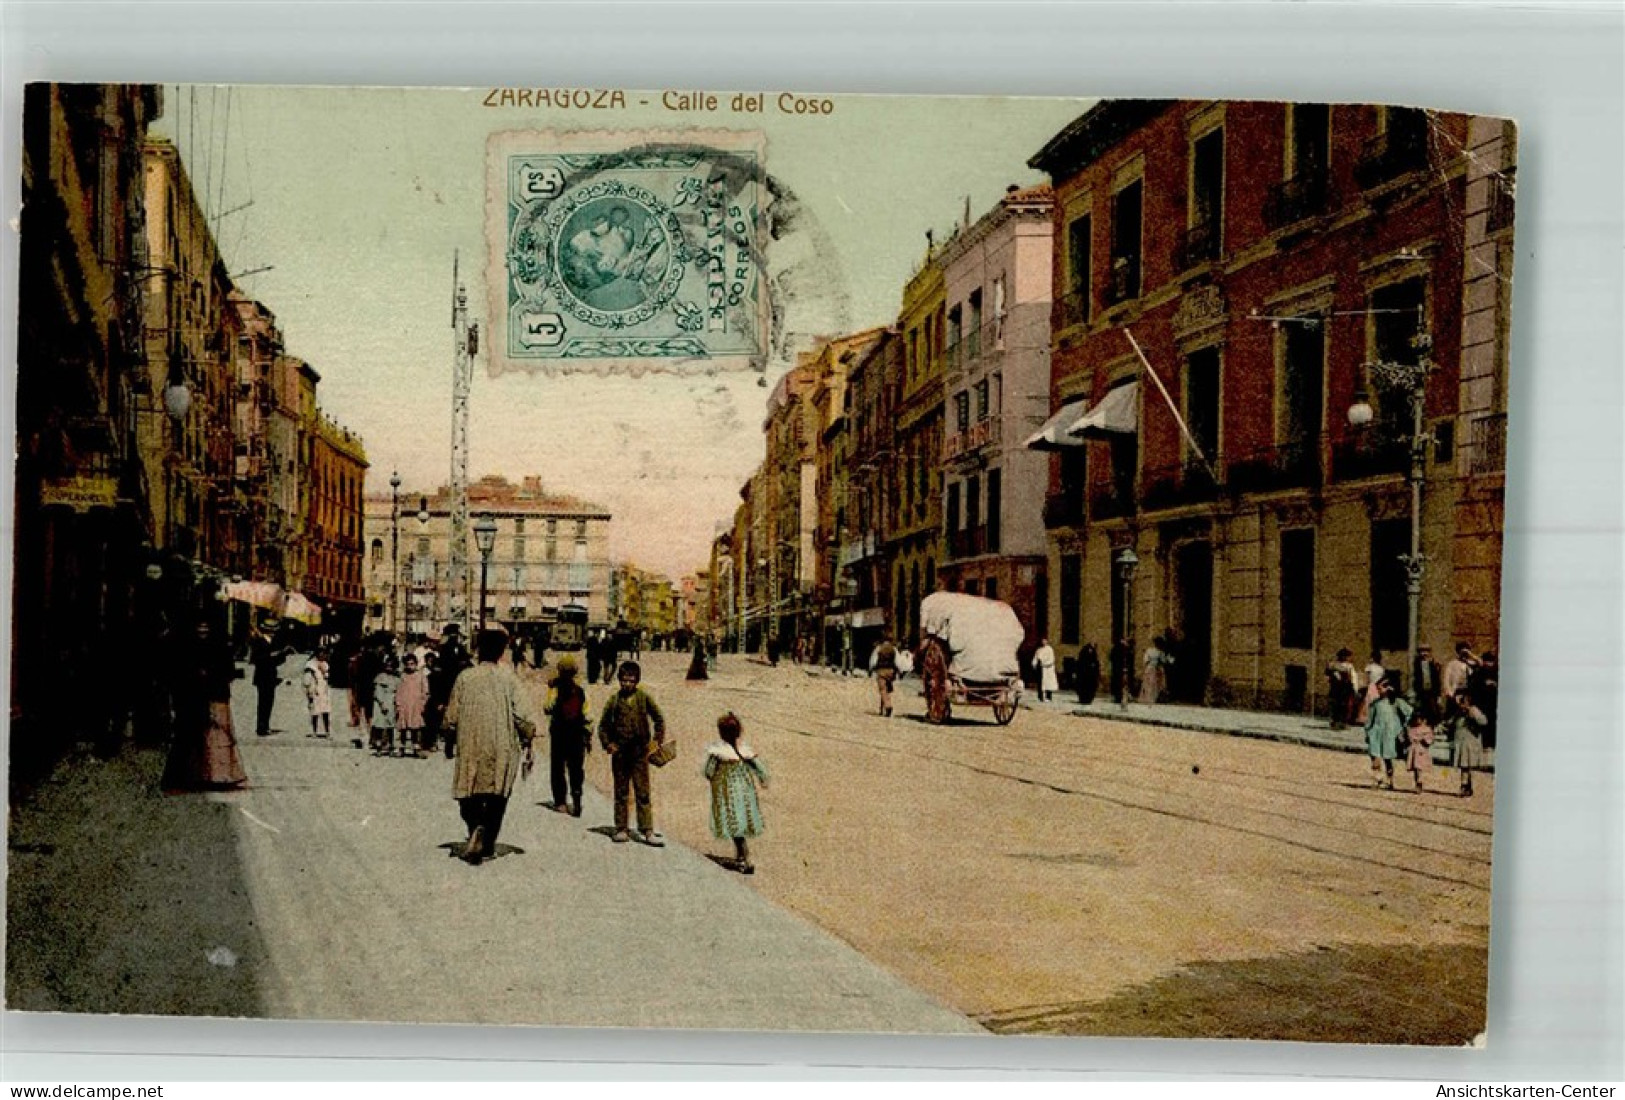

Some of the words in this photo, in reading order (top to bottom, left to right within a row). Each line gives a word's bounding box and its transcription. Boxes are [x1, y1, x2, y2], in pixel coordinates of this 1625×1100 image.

[483, 88, 627, 109] ZARAGOZA
[662, 90, 718, 111] Calle
[731, 92, 764, 113] del
[777, 92, 834, 114] Coso
[727, 205, 751, 307] CORREOS
[527, 315, 558, 337] 5
